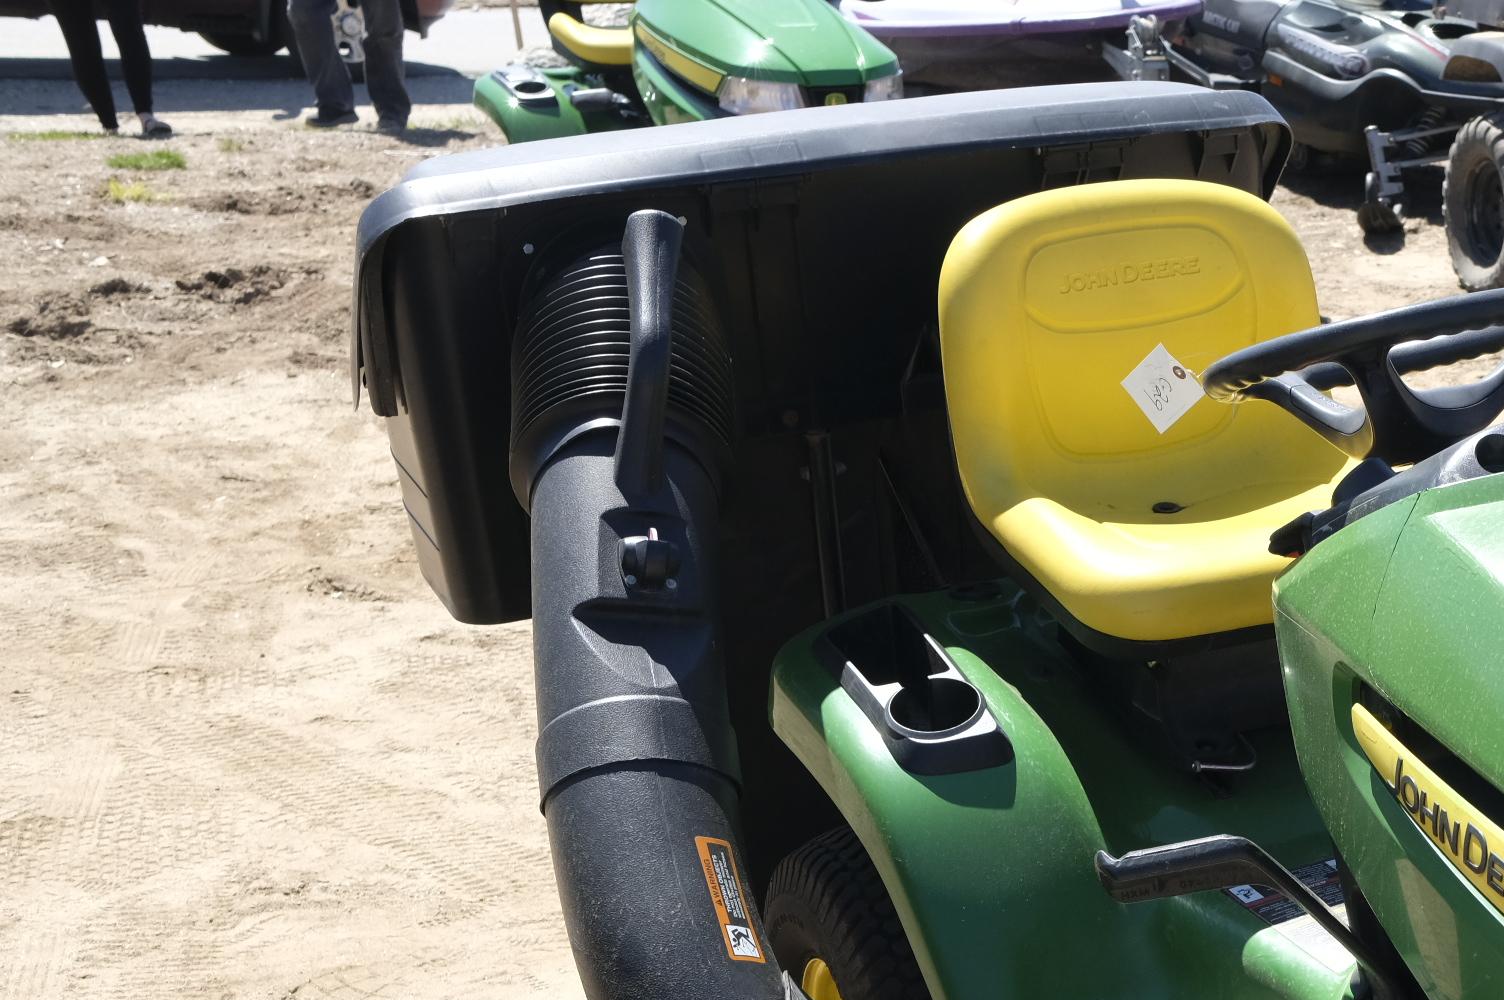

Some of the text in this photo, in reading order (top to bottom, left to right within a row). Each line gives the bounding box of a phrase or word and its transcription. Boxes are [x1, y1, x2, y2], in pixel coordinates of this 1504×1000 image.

[1059, 256, 1201, 295] JOHN DEERE
[1387, 756, 1460, 857] JOHN
[703, 859, 720, 898] WARNING
[711, 854, 724, 884] OBJECTS
[720, 885, 733, 912] THROWN
